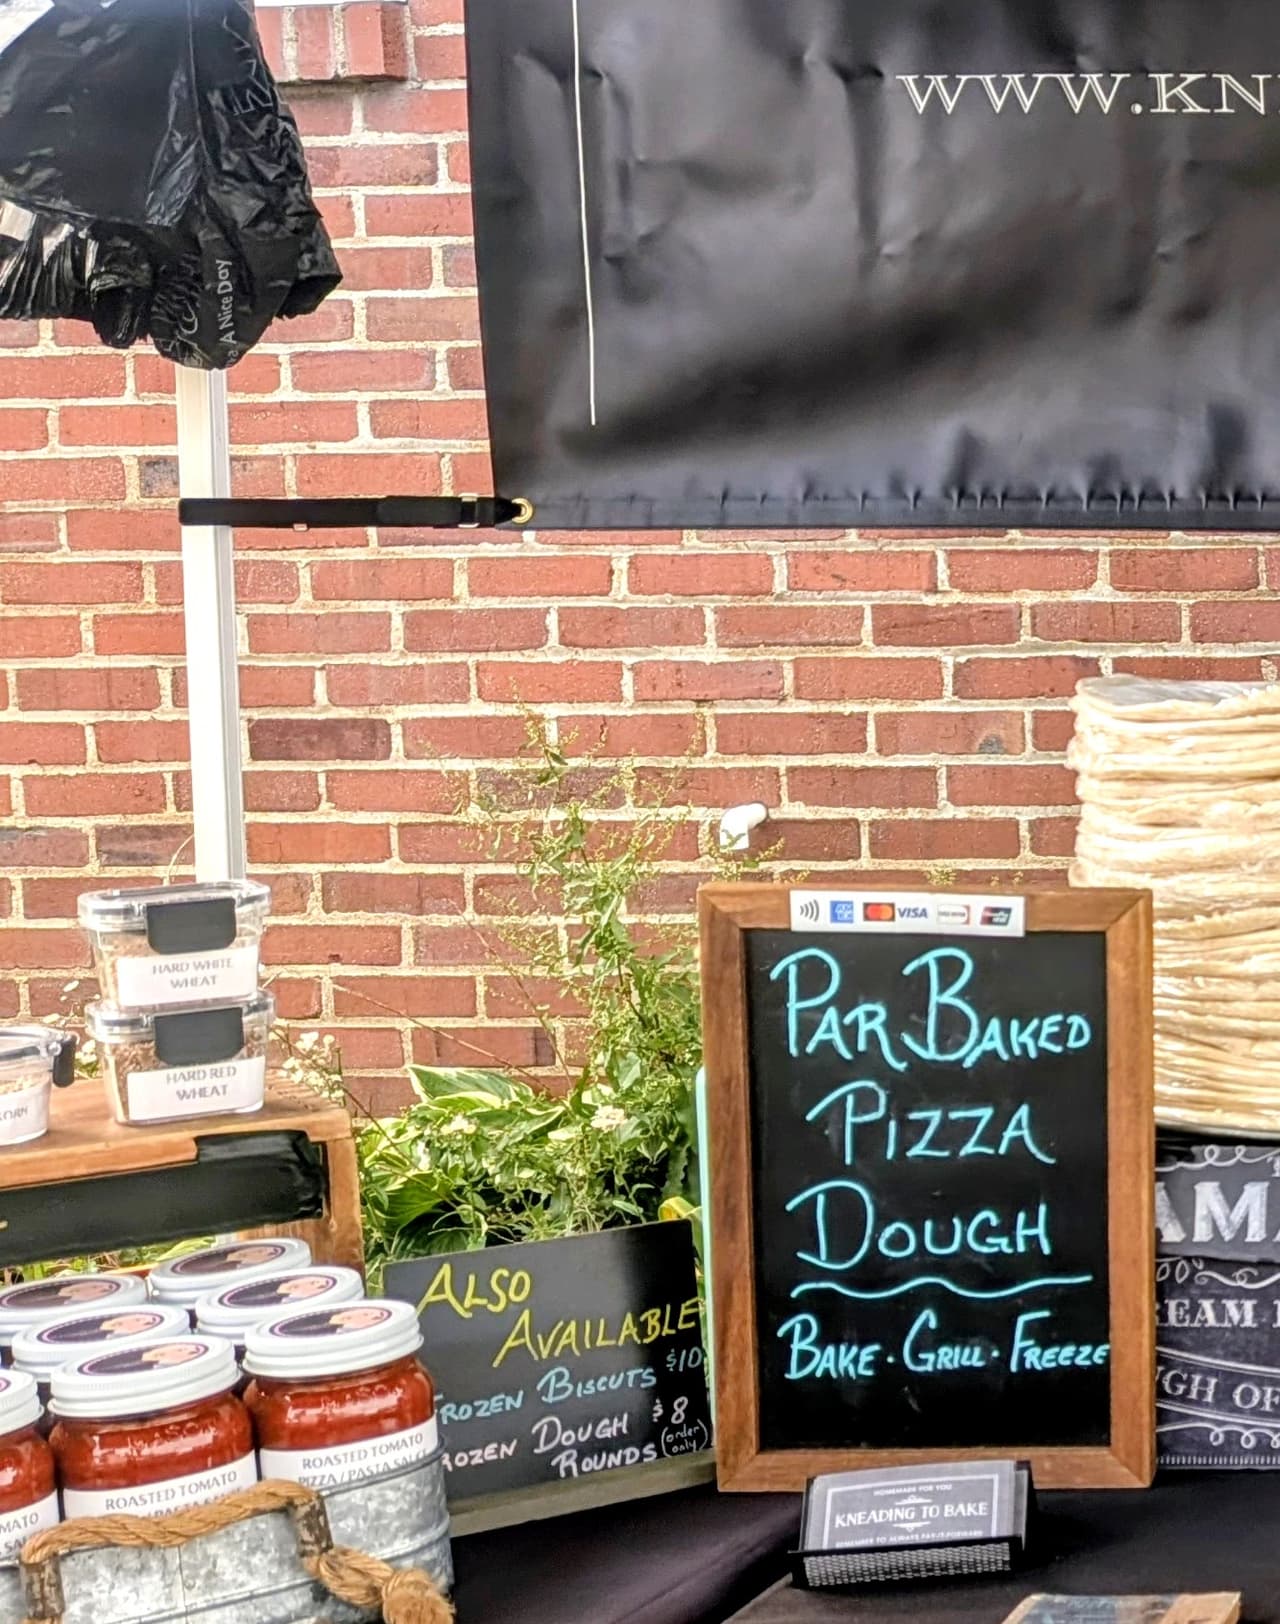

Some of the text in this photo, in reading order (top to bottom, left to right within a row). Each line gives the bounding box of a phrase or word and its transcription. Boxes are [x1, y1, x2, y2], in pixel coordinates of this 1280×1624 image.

[215, 259, 234, 295] Day
[217, 295, 235, 331] Nice
[219, 331, 237, 345] A
[897, 906, 929, 919] VISA
[152, 957, 234, 976] HARD WHITE
[169, 974, 218, 989] WHEAT
[770, 946, 1092, 1072] PAR BAKED
[165, 1065, 238, 1086] HARD RED
[175, 1084, 229, 1102] WHEAT
[0, 1105, 29, 1121] ORN
[805, 1080, 1057, 1166] PIZZA
[785, 1180, 1053, 1271] DOUGH
[415, 1262, 532, 1319] ALSO
[491, 1297, 706, 1368] AVAILABLE
[777, 1308, 1112, 1379] BAKE GRILL FREEZE
[664, 1346, 703, 1373] $10
[302, 1432, 424, 1470] ROASTED TOMATO
[531, 1411, 629, 1455] DOUGH
[348, 1460, 392, 1481] PASTA
[550, 1442, 658, 1479] ROUNDS
[105, 1487, 176, 1511] ROASTED
[179, 1470, 237, 1498] TOMATO
[834, 1501, 989, 1529] KNEADING TO BAKE
[876, 1536, 887, 1545] TO
